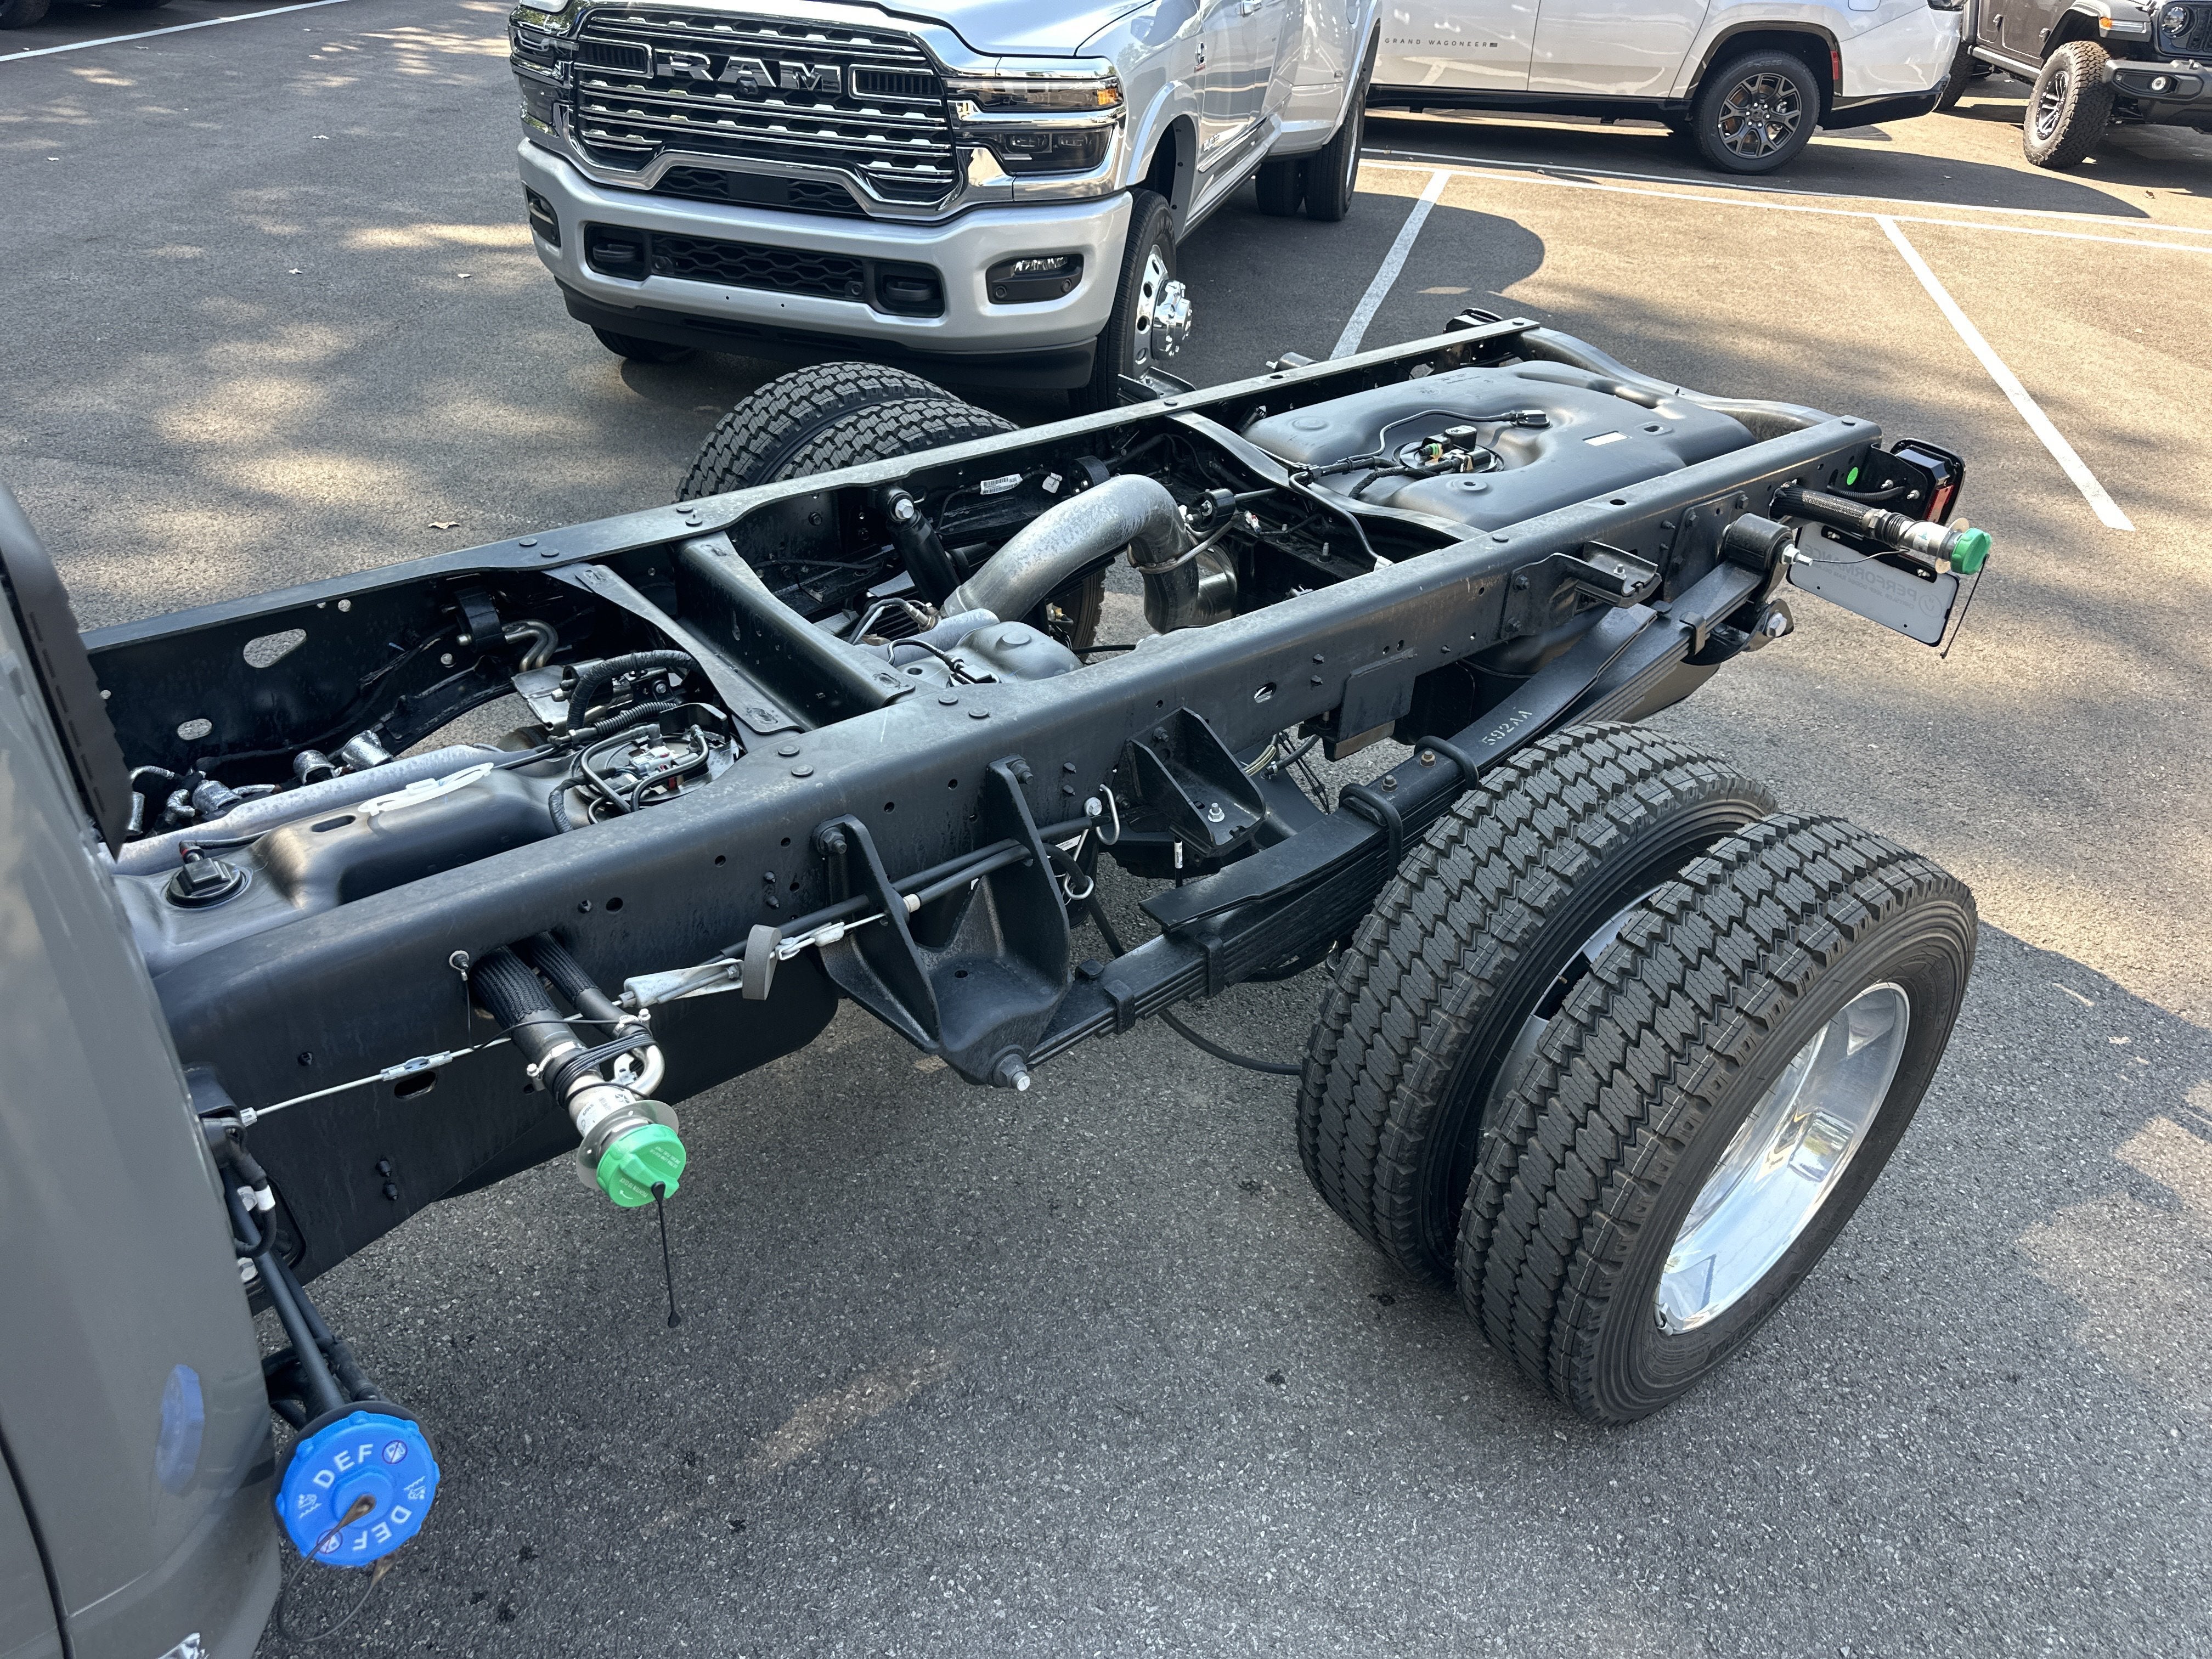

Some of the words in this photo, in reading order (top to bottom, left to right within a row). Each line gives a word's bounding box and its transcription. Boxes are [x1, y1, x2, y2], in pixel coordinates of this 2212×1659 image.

[654, 48, 842, 93] RAM
[1481, 710, 1533, 746] 592AA
[633, 1185, 648, 1198] TIGHTEN
[313, 1443, 374, 1488] DEF
[352, 1505, 412, 1551] DEF
